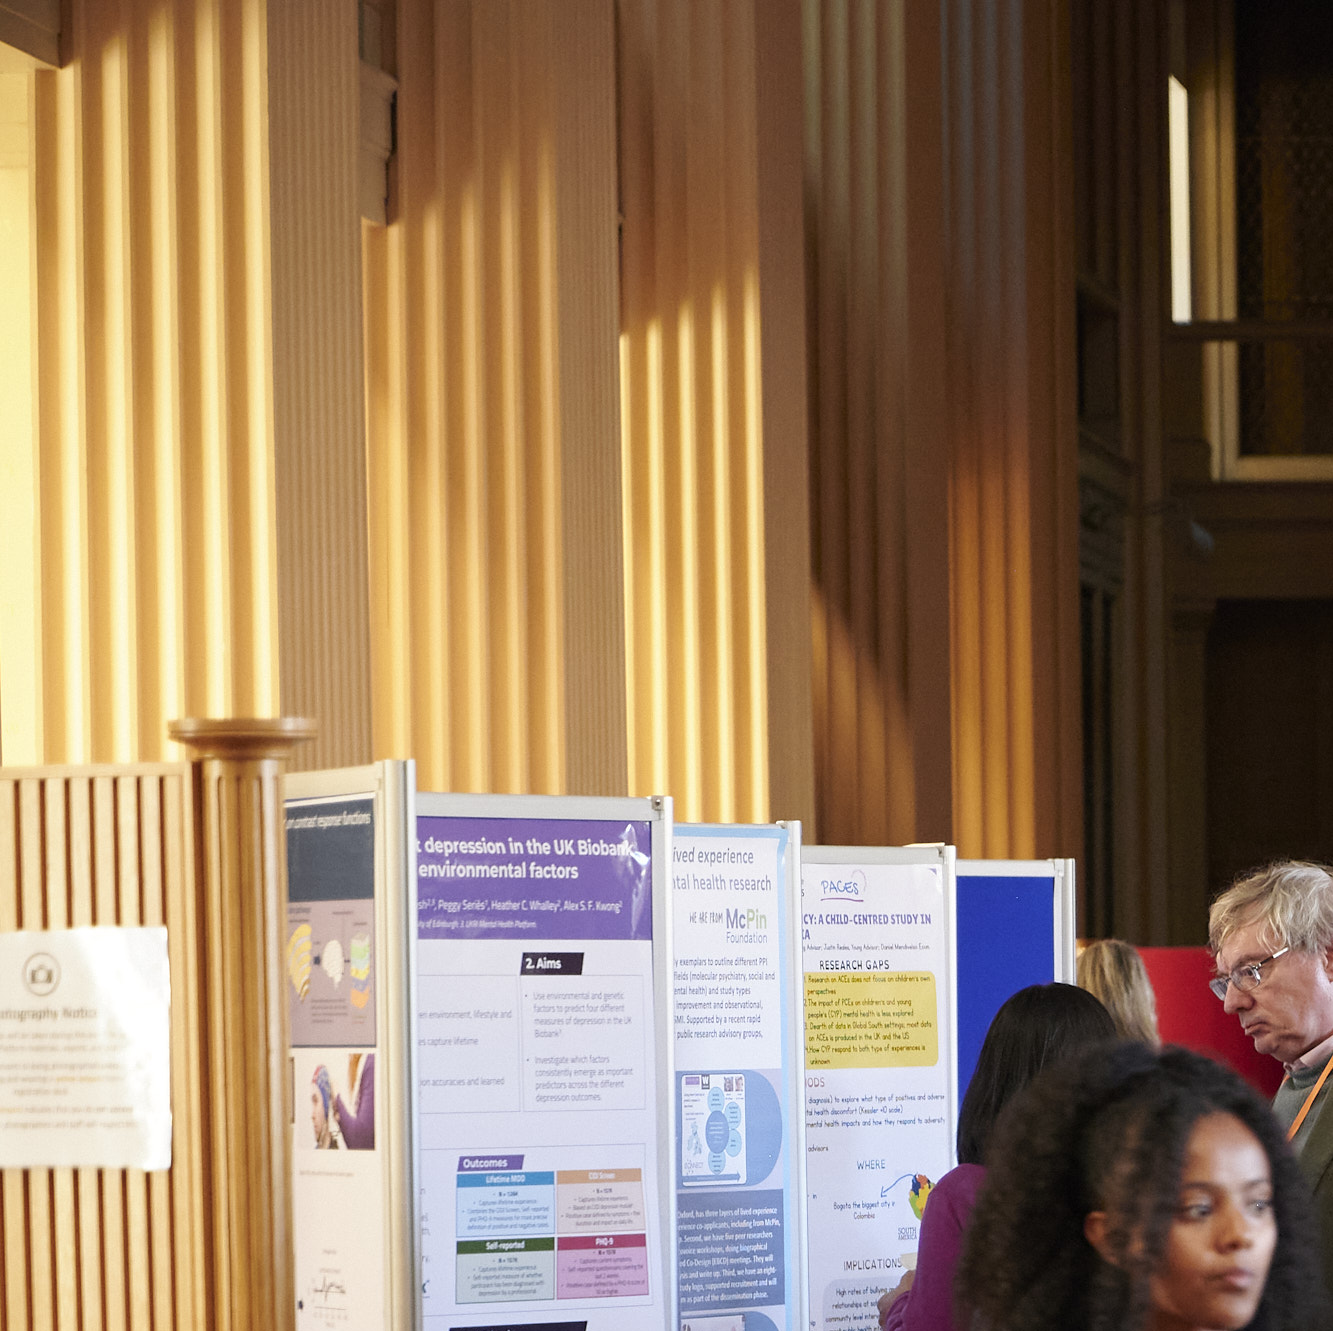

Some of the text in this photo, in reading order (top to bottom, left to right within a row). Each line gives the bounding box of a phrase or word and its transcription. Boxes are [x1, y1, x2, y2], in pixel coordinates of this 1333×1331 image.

[425, 837, 631, 856] depression in the UK Biobank
[673, 846, 754, 867] ived experience
[419, 861, 579, 878] environmental factors
[693, 874, 726, 890] health
[730, 876, 771, 891] research
[821, 881, 859, 894] PACES
[709, 911, 723, 923] FROM
[726, 908, 767, 929] McPin
[803, 914, 817, 924] CY:
[726, 931, 767, 944] Foundation
